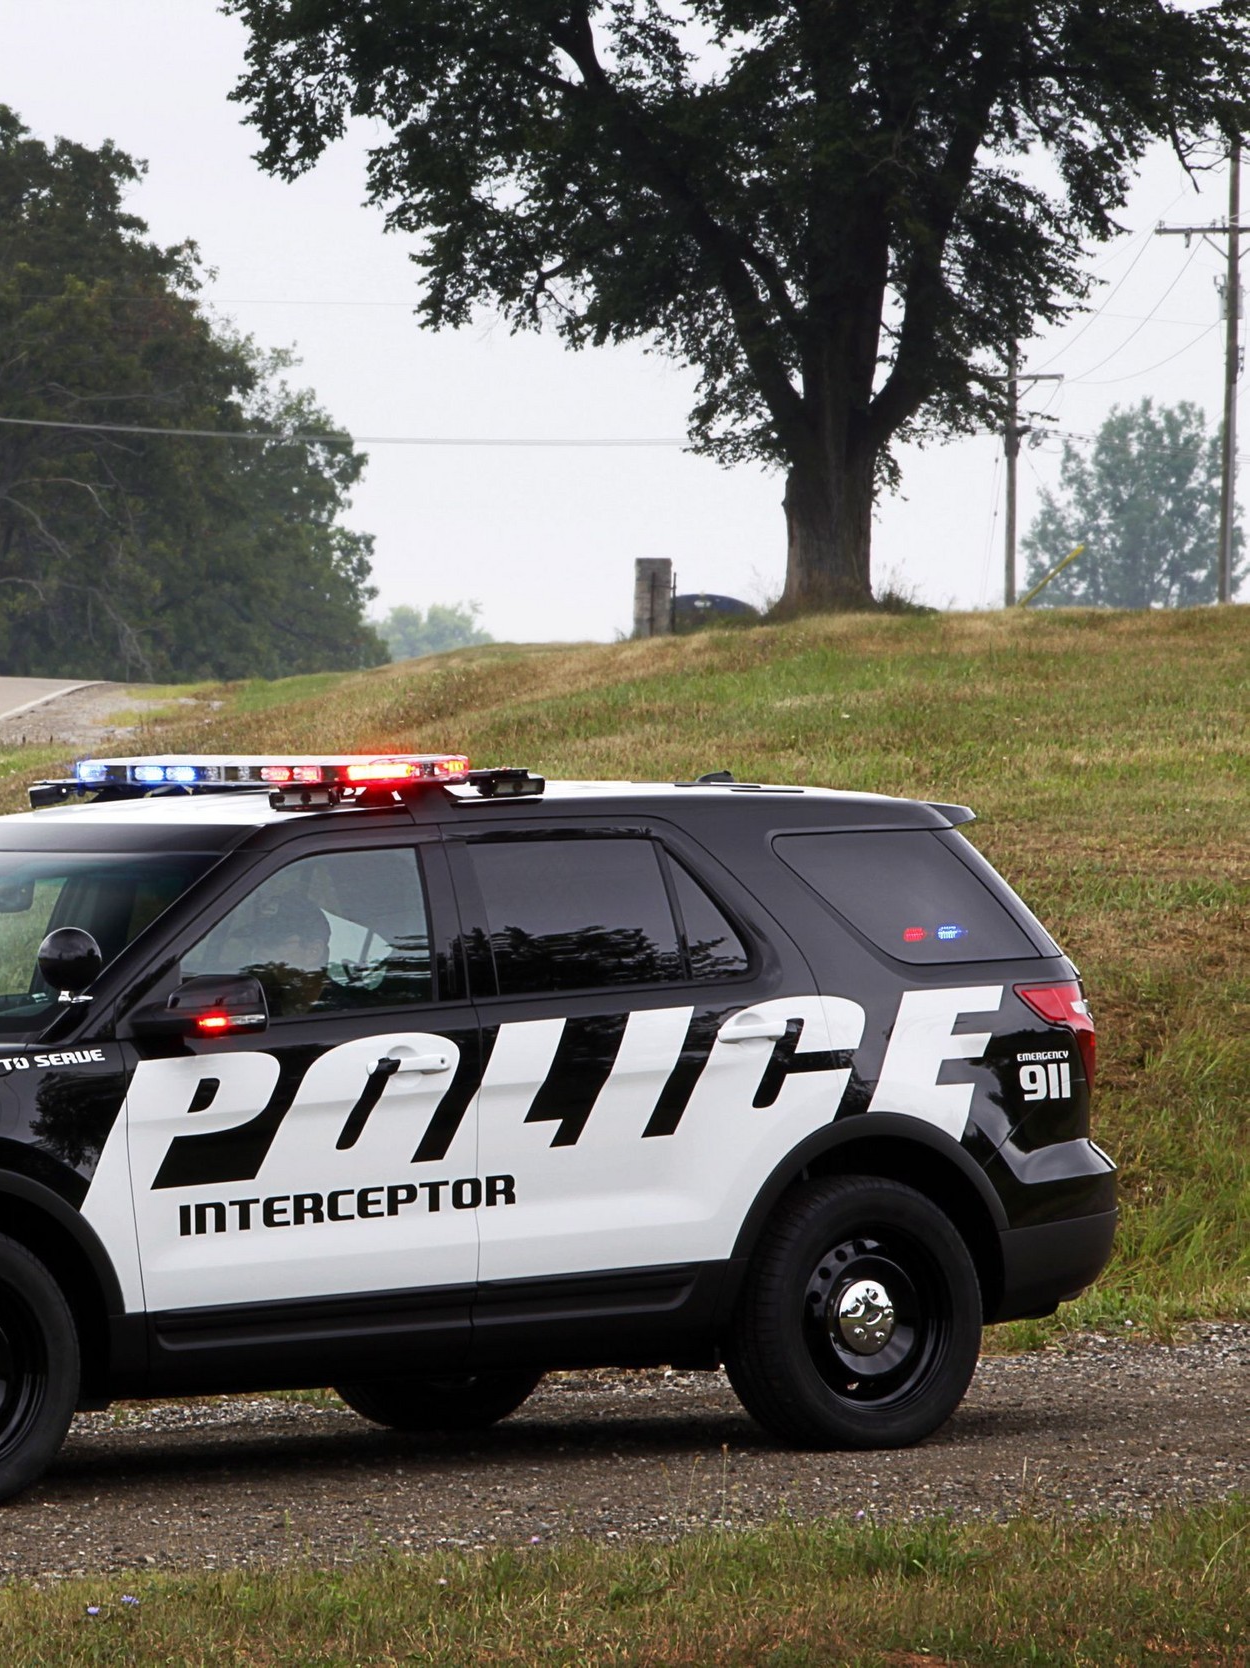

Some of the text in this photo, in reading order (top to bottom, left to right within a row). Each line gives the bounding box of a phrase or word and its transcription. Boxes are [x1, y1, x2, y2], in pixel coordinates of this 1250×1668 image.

[34, 1049, 106, 1068] SERVE
[1016, 1050, 1069, 1062] EMERGENCY
[100, 985, 1004, 1192] POLICE
[1019, 1062, 1072, 1101] 911
[179, 1174, 517, 1237] INTERCEPTOR
